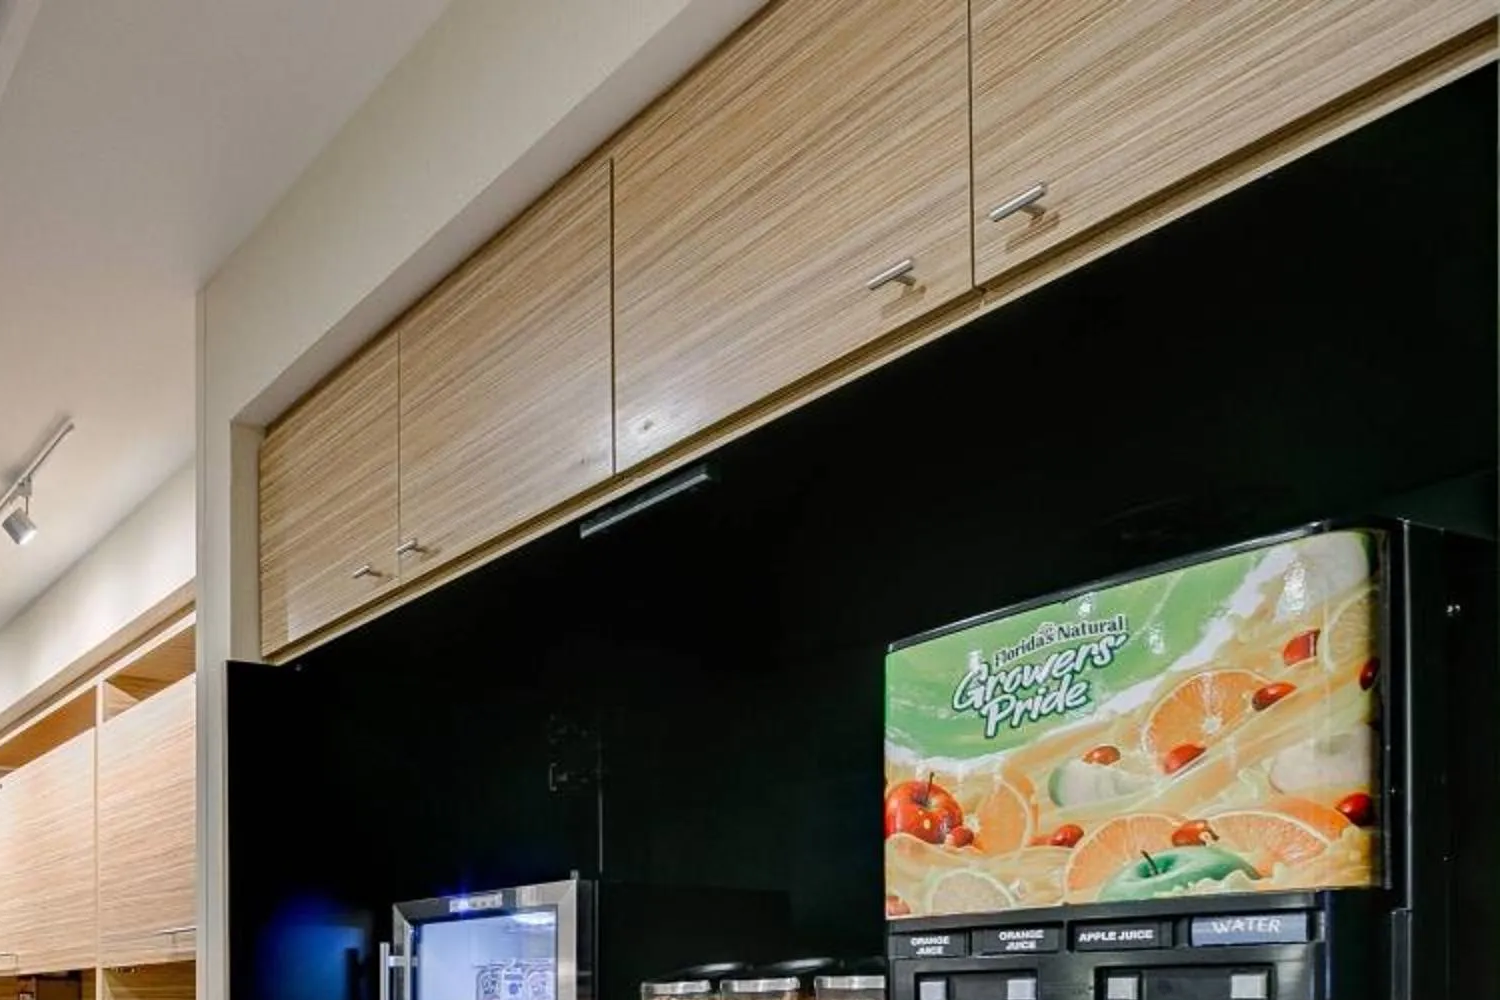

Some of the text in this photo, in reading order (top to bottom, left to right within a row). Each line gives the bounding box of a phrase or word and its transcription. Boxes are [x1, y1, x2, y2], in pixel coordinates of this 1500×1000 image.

[994, 614, 1124, 667] Florida's Natural
[980, 674, 1091, 738] Pride
[1211, 917, 1282, 934] WATER
[910, 935, 949, 947] ORANGE
[999, 929, 1044, 941] ORANGE
[1078, 929, 1154, 943] APPLE JUICE
[915, 946, 944, 955] JUICE
[1005, 940, 1037, 950] JUICE
